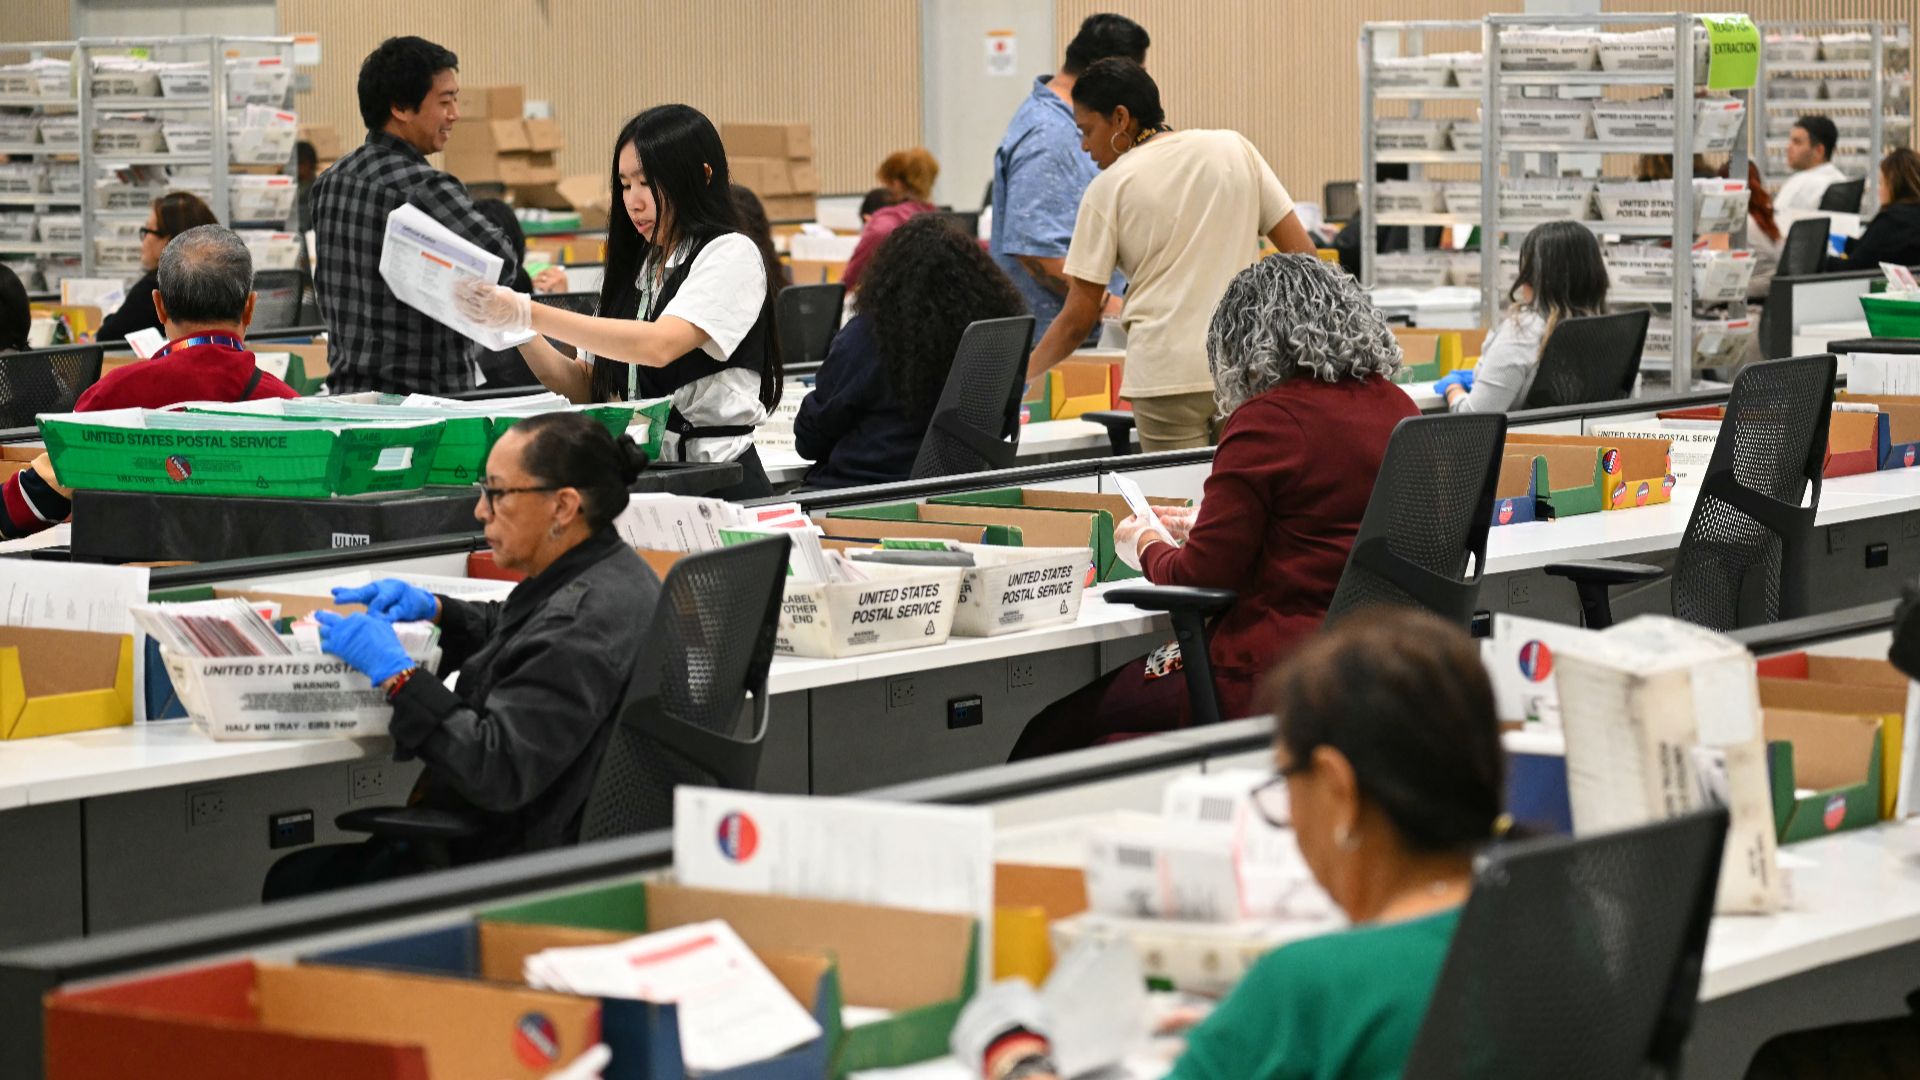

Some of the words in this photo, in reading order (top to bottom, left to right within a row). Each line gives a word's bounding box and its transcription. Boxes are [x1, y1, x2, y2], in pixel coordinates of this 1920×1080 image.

[1714, 42, 1756, 54] EXTRACTION
[82, 430, 125, 445] UNITED
[127, 433, 174, 447] STATES
[176, 436, 228, 448] POSTAL
[230, 436, 288, 449] SERVICE
[1658, 434, 1690, 442] POSTAL
[1692, 434, 1717, 442] SERVI
[1008, 570, 1040, 587] UNITED
[1041, 565, 1073, 582] STATES
[858, 588, 899, 606] UNITED
[900, 583, 940, 600] STATES
[1002, 588, 1035, 605] POSTAL
[1037, 581, 1074, 598] SERVICE
[783, 604, 818, 614] OTHER
[852, 607, 894, 624] POSTAL
[896, 600, 942, 619] SERVICE
[792, 614, 814, 624] END
[203, 664, 254, 676] UNITED
[256, 663, 310, 676] STATES
[292, 681, 341, 690] WARNING
[226, 724, 250, 732] HALF
[274, 722, 300, 730] TRAY
[308, 721, 330, 730] EIRS
